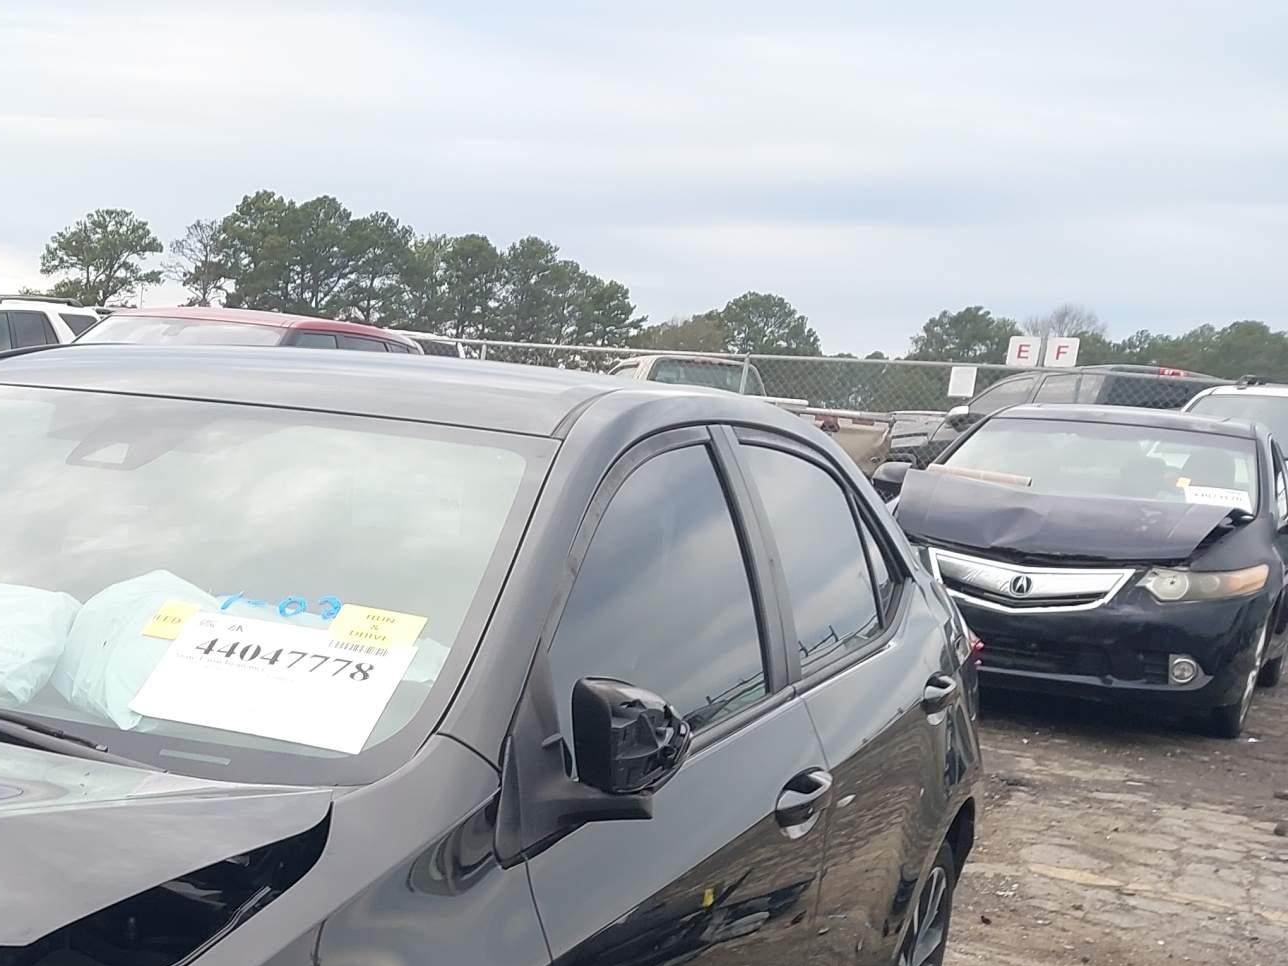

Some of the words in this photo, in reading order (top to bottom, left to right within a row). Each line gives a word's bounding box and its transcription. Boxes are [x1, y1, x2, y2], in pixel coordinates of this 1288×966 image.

[1017, 344, 1031, 359] E
[1056, 345, 1069, 360] F
[195, 638, 374, 681] 44047778
